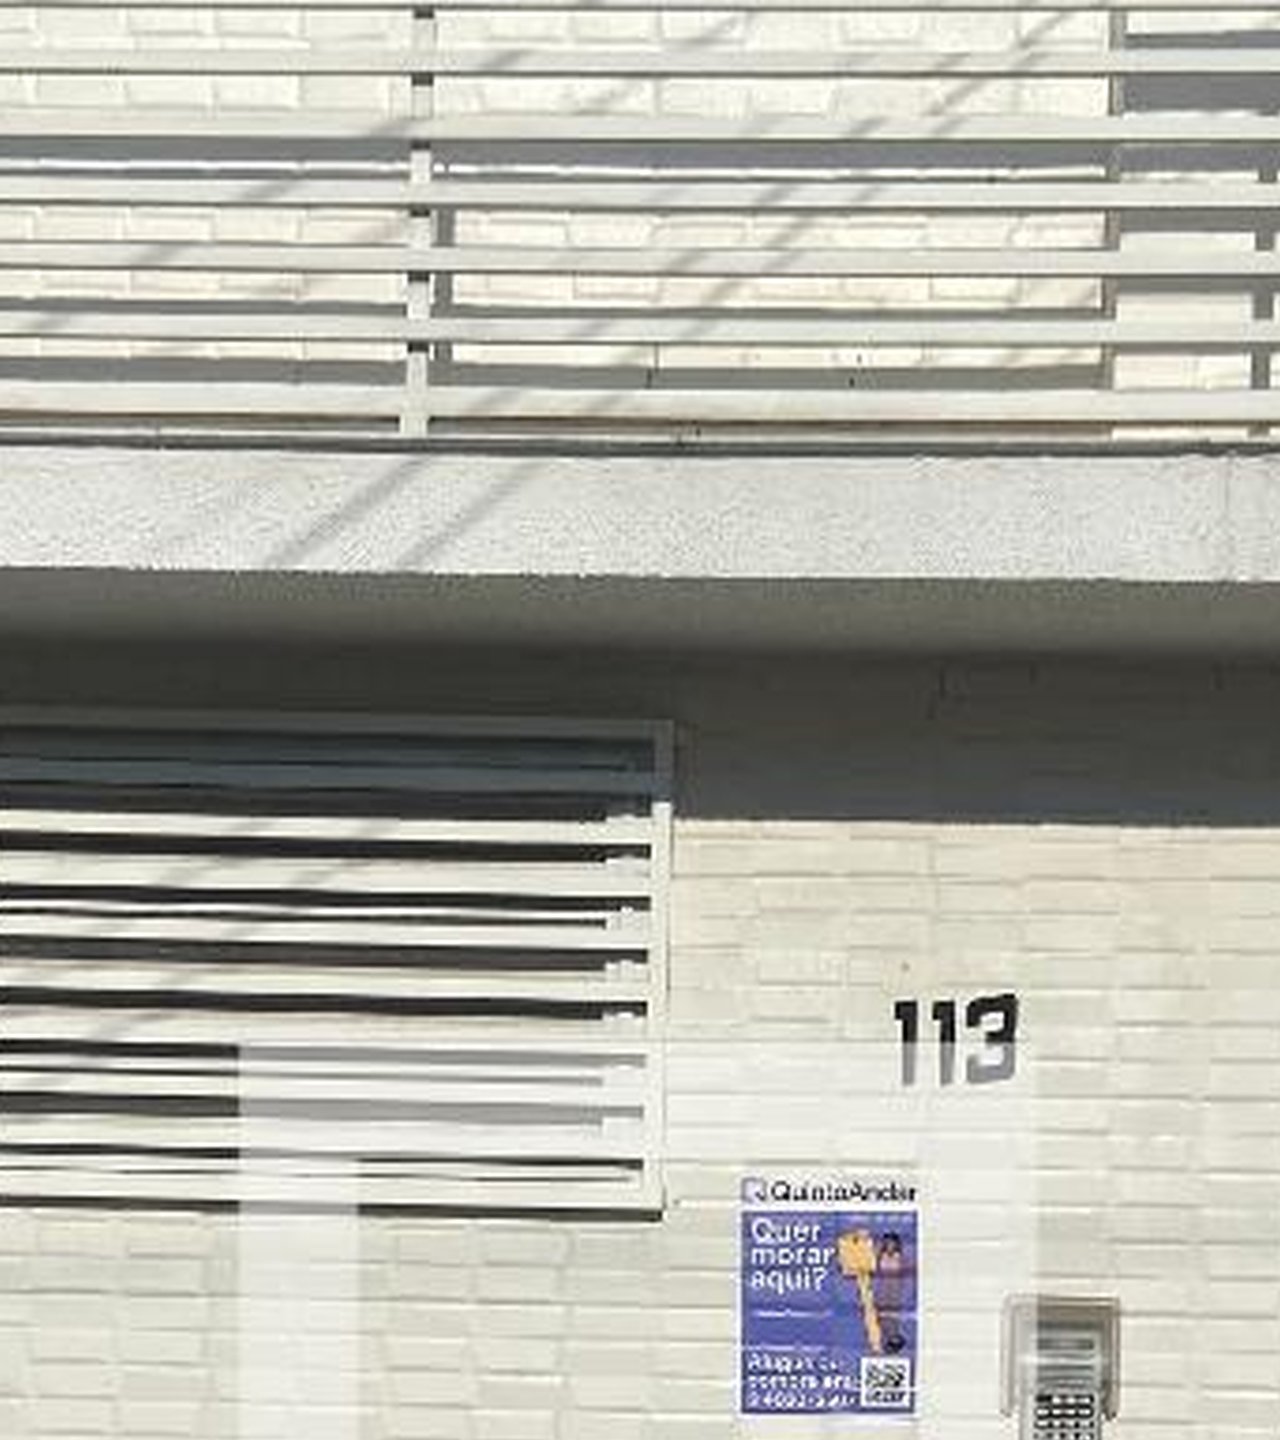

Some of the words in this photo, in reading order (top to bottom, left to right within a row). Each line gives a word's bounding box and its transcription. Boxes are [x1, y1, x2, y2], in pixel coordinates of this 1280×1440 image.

[894, 993, 1021, 1087] 113
[751, 1217, 821, 1244] Quer
[751, 1246, 836, 1266] morar
[751, 1267, 828, 1295] aqui?
